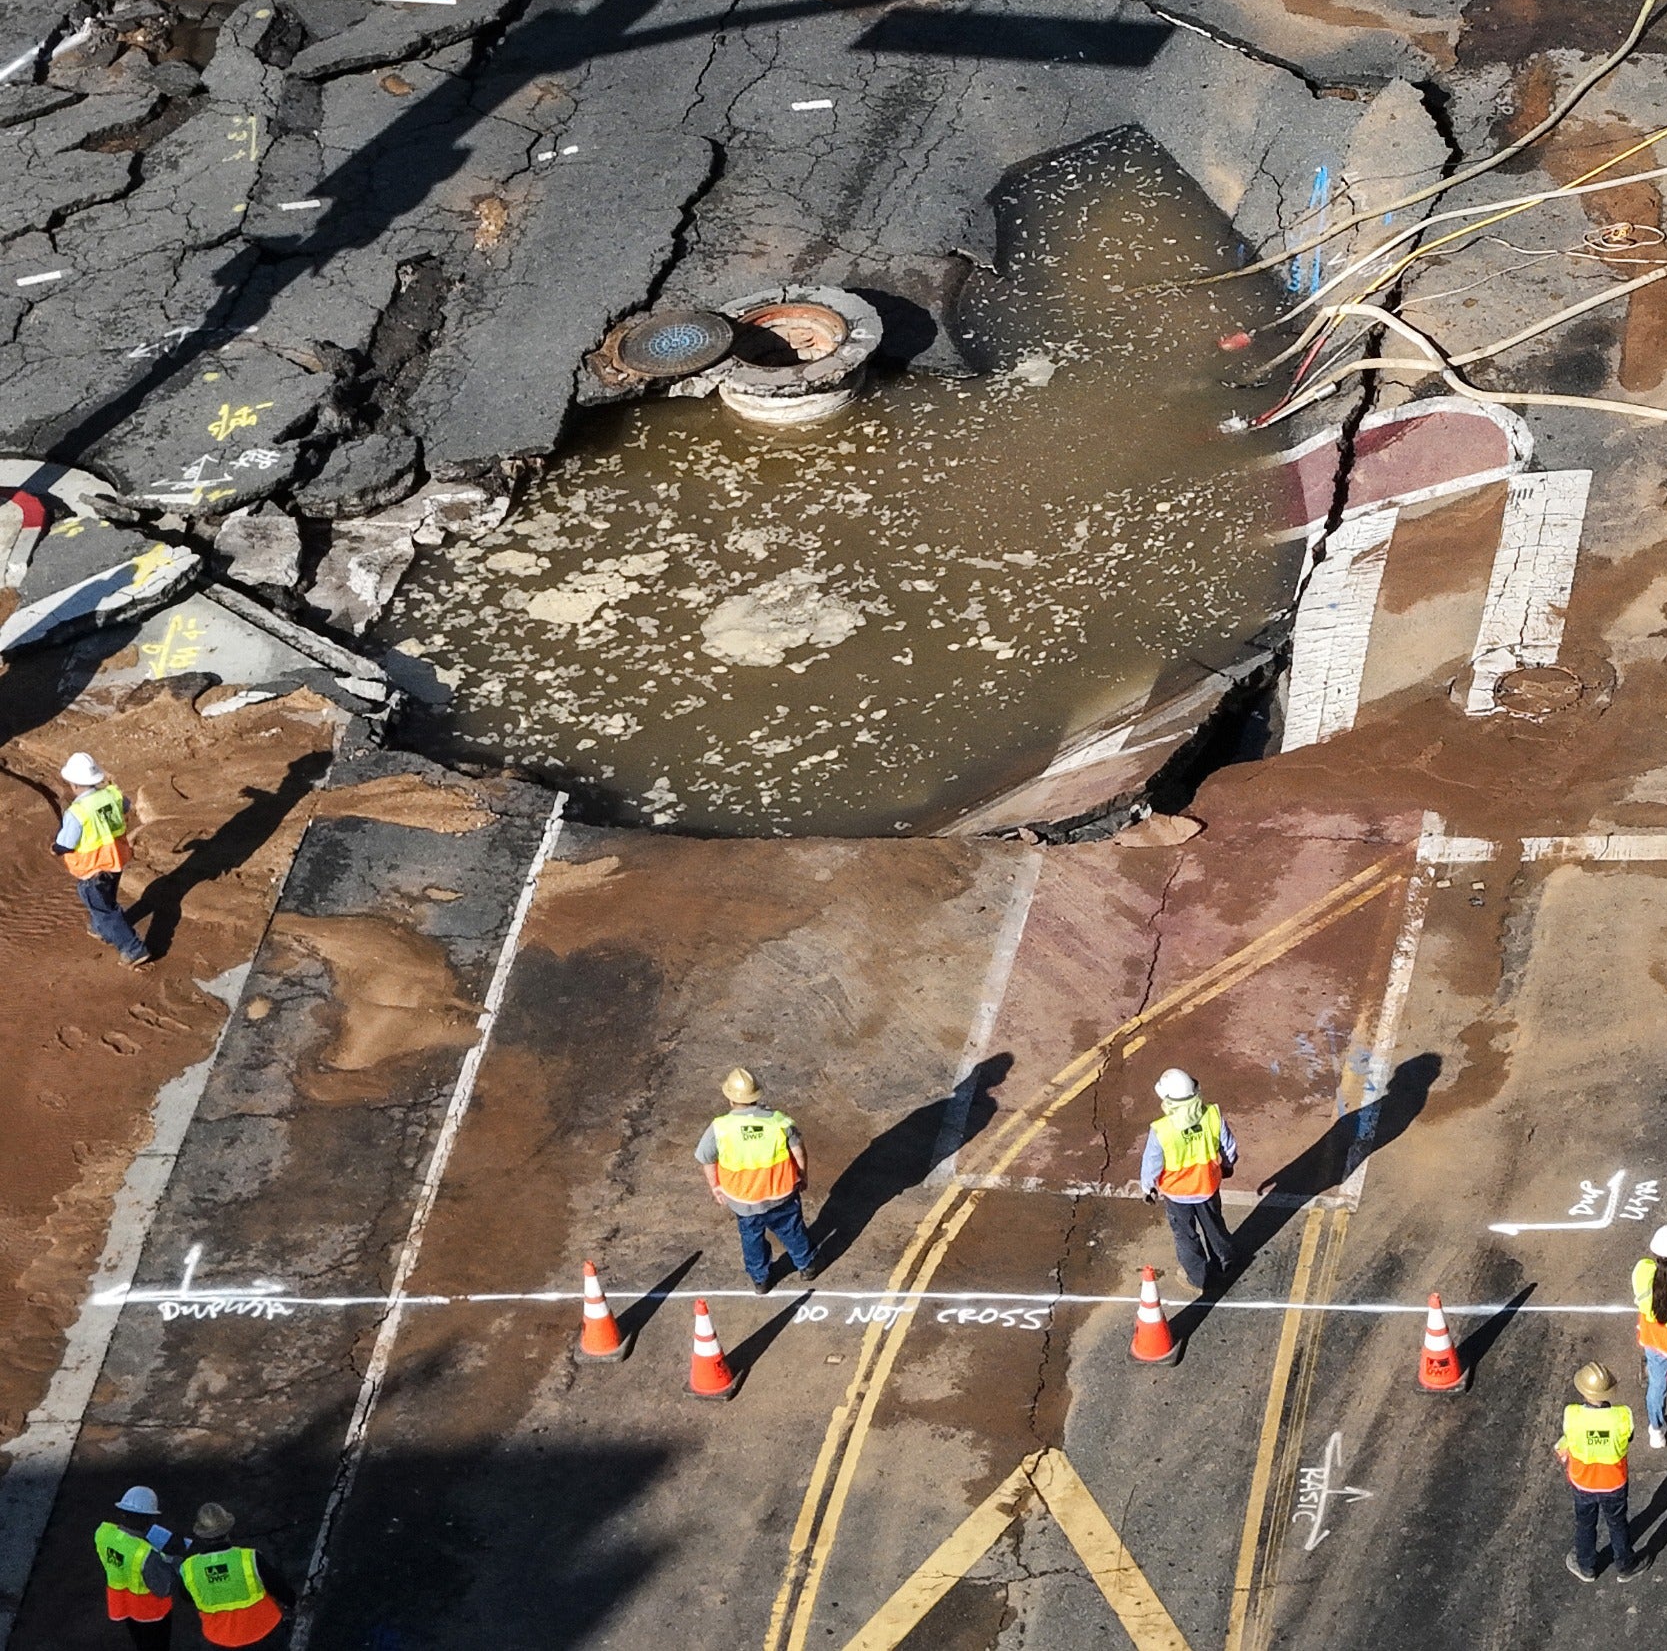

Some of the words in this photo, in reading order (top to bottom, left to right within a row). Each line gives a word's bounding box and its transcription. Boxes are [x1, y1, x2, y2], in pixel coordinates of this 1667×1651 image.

[743, 1133, 764, 1141] DWP
[793, 1304, 828, 1325] DO
[845, 1304, 918, 1329] NOT
[936, 1305, 1055, 1331] CROSS
[1587, 1438, 1610, 1446] DWP
